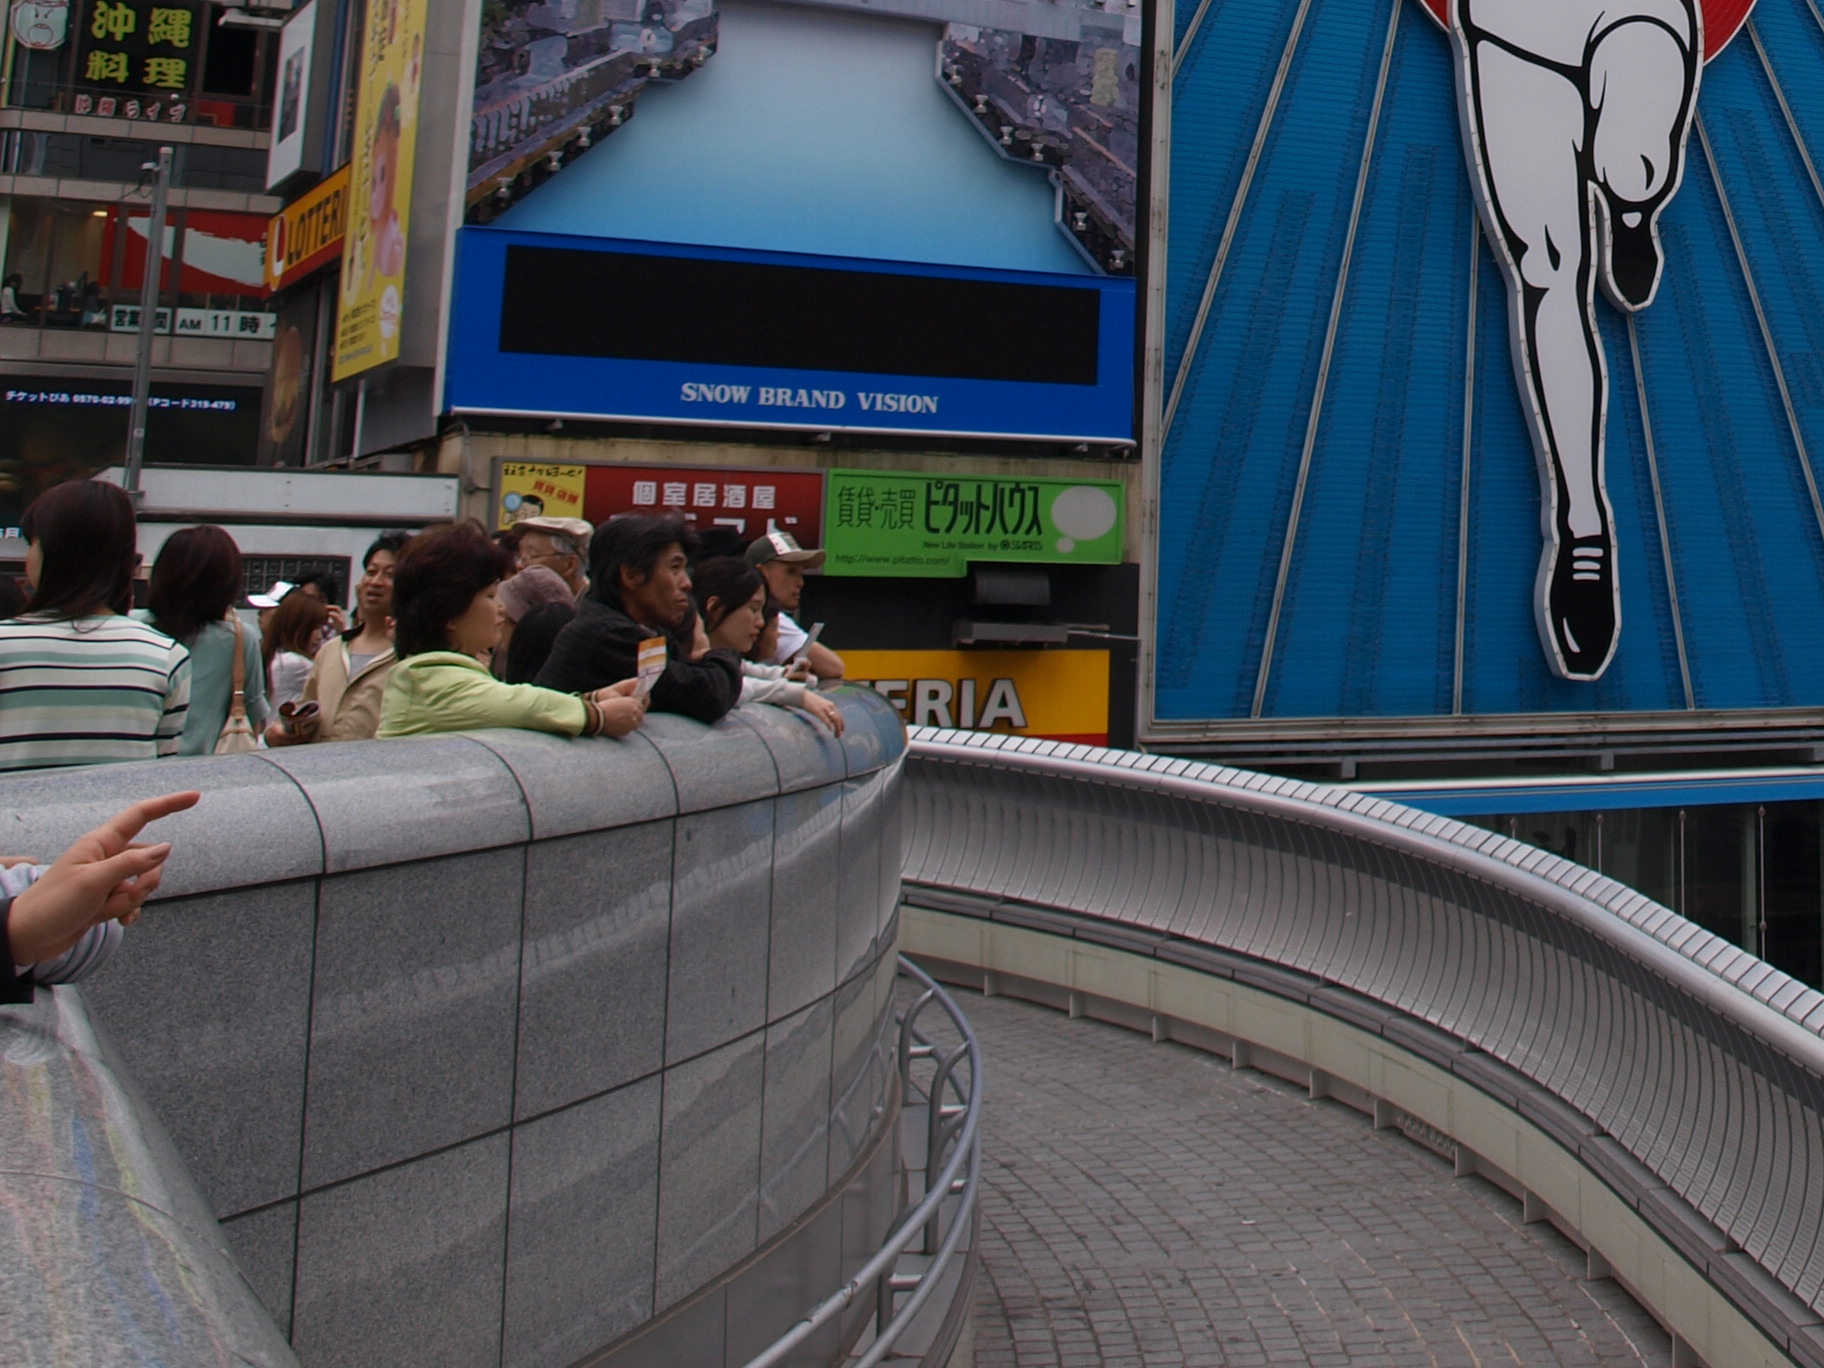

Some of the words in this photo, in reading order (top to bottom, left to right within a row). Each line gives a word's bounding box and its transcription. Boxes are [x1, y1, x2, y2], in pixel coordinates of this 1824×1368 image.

[89, 0, 193, 49] 沖縄
[84, 49, 188, 90] 料理
[178, 317, 202, 331] AM
[680, 381, 752, 406] SNOW
[757, 386, 845, 410] BRAND
[857, 391, 939, 415] VISION
[631, 479, 778, 510] 個室居酒屋
[835, 484, 916, 533] 賃貸・売買
[923, 479, 1044, 536] ピタットハウス
[987, 541, 999, 553] by
